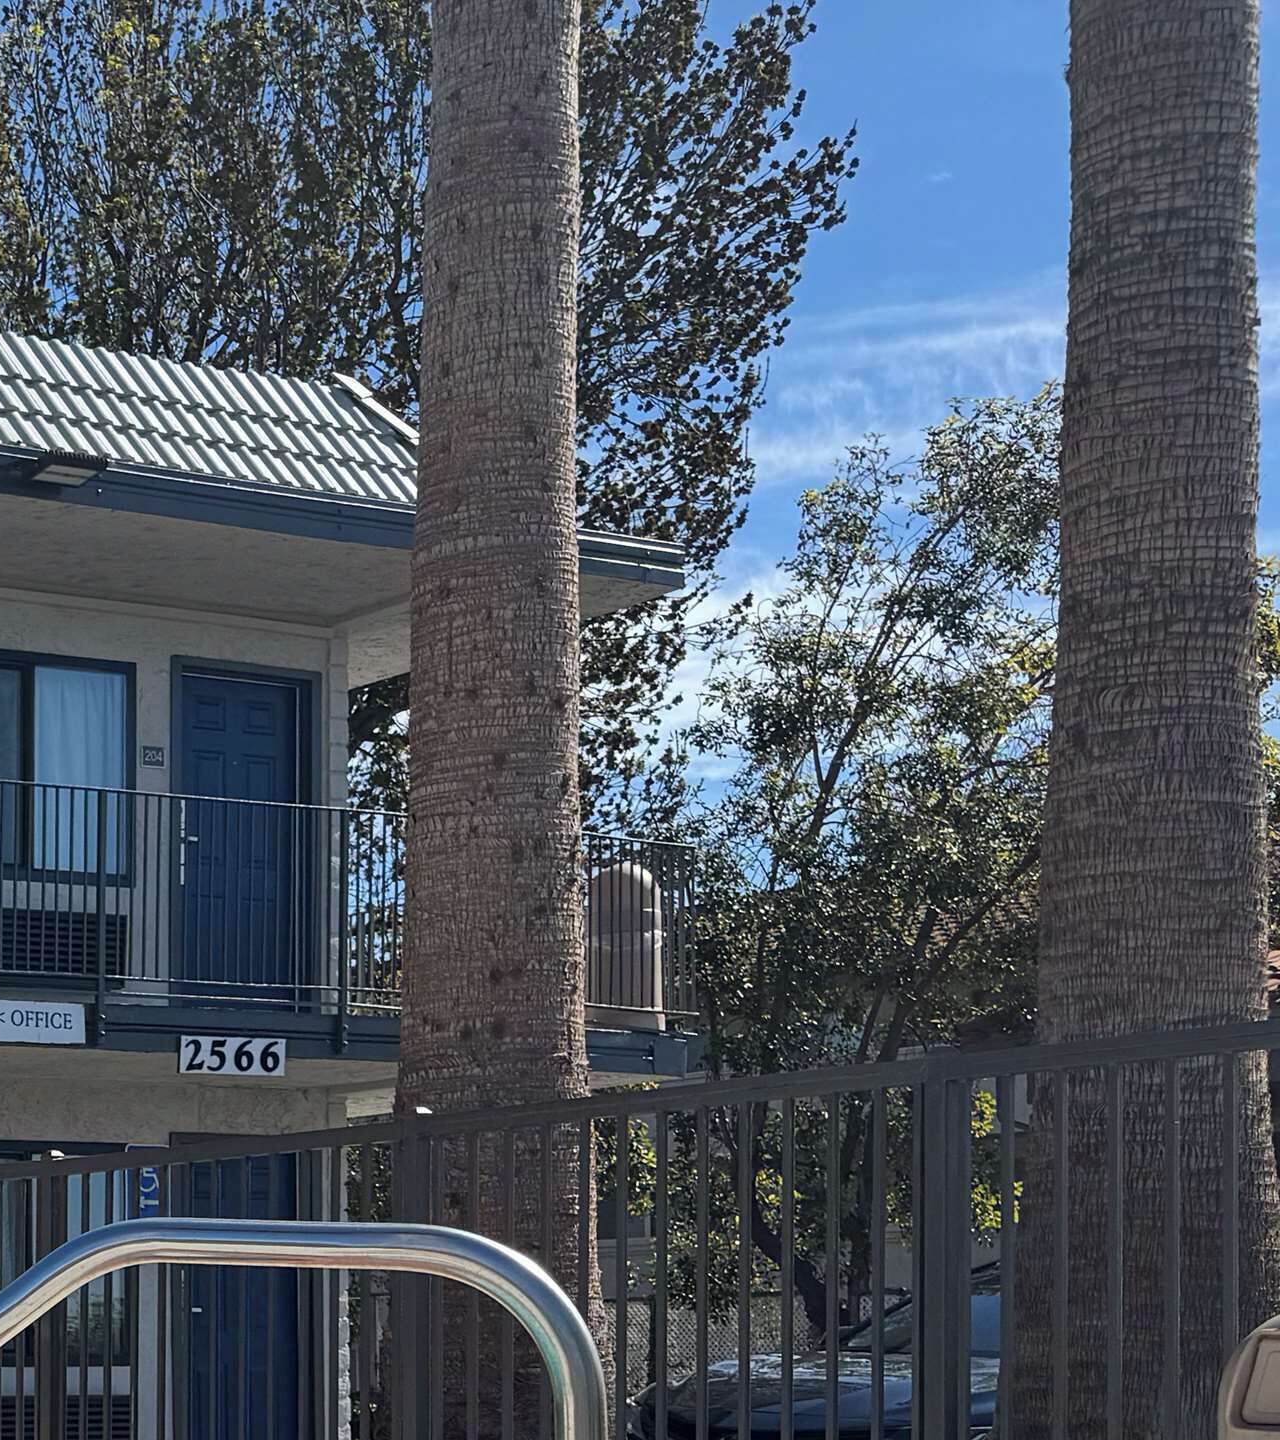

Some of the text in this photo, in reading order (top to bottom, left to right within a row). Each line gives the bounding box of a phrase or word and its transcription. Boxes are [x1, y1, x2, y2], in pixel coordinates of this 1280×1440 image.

[144, 750, 162, 761] 204
[11, 1009, 73, 1030] OFFICE
[184, 1039, 280, 1073] 2566
